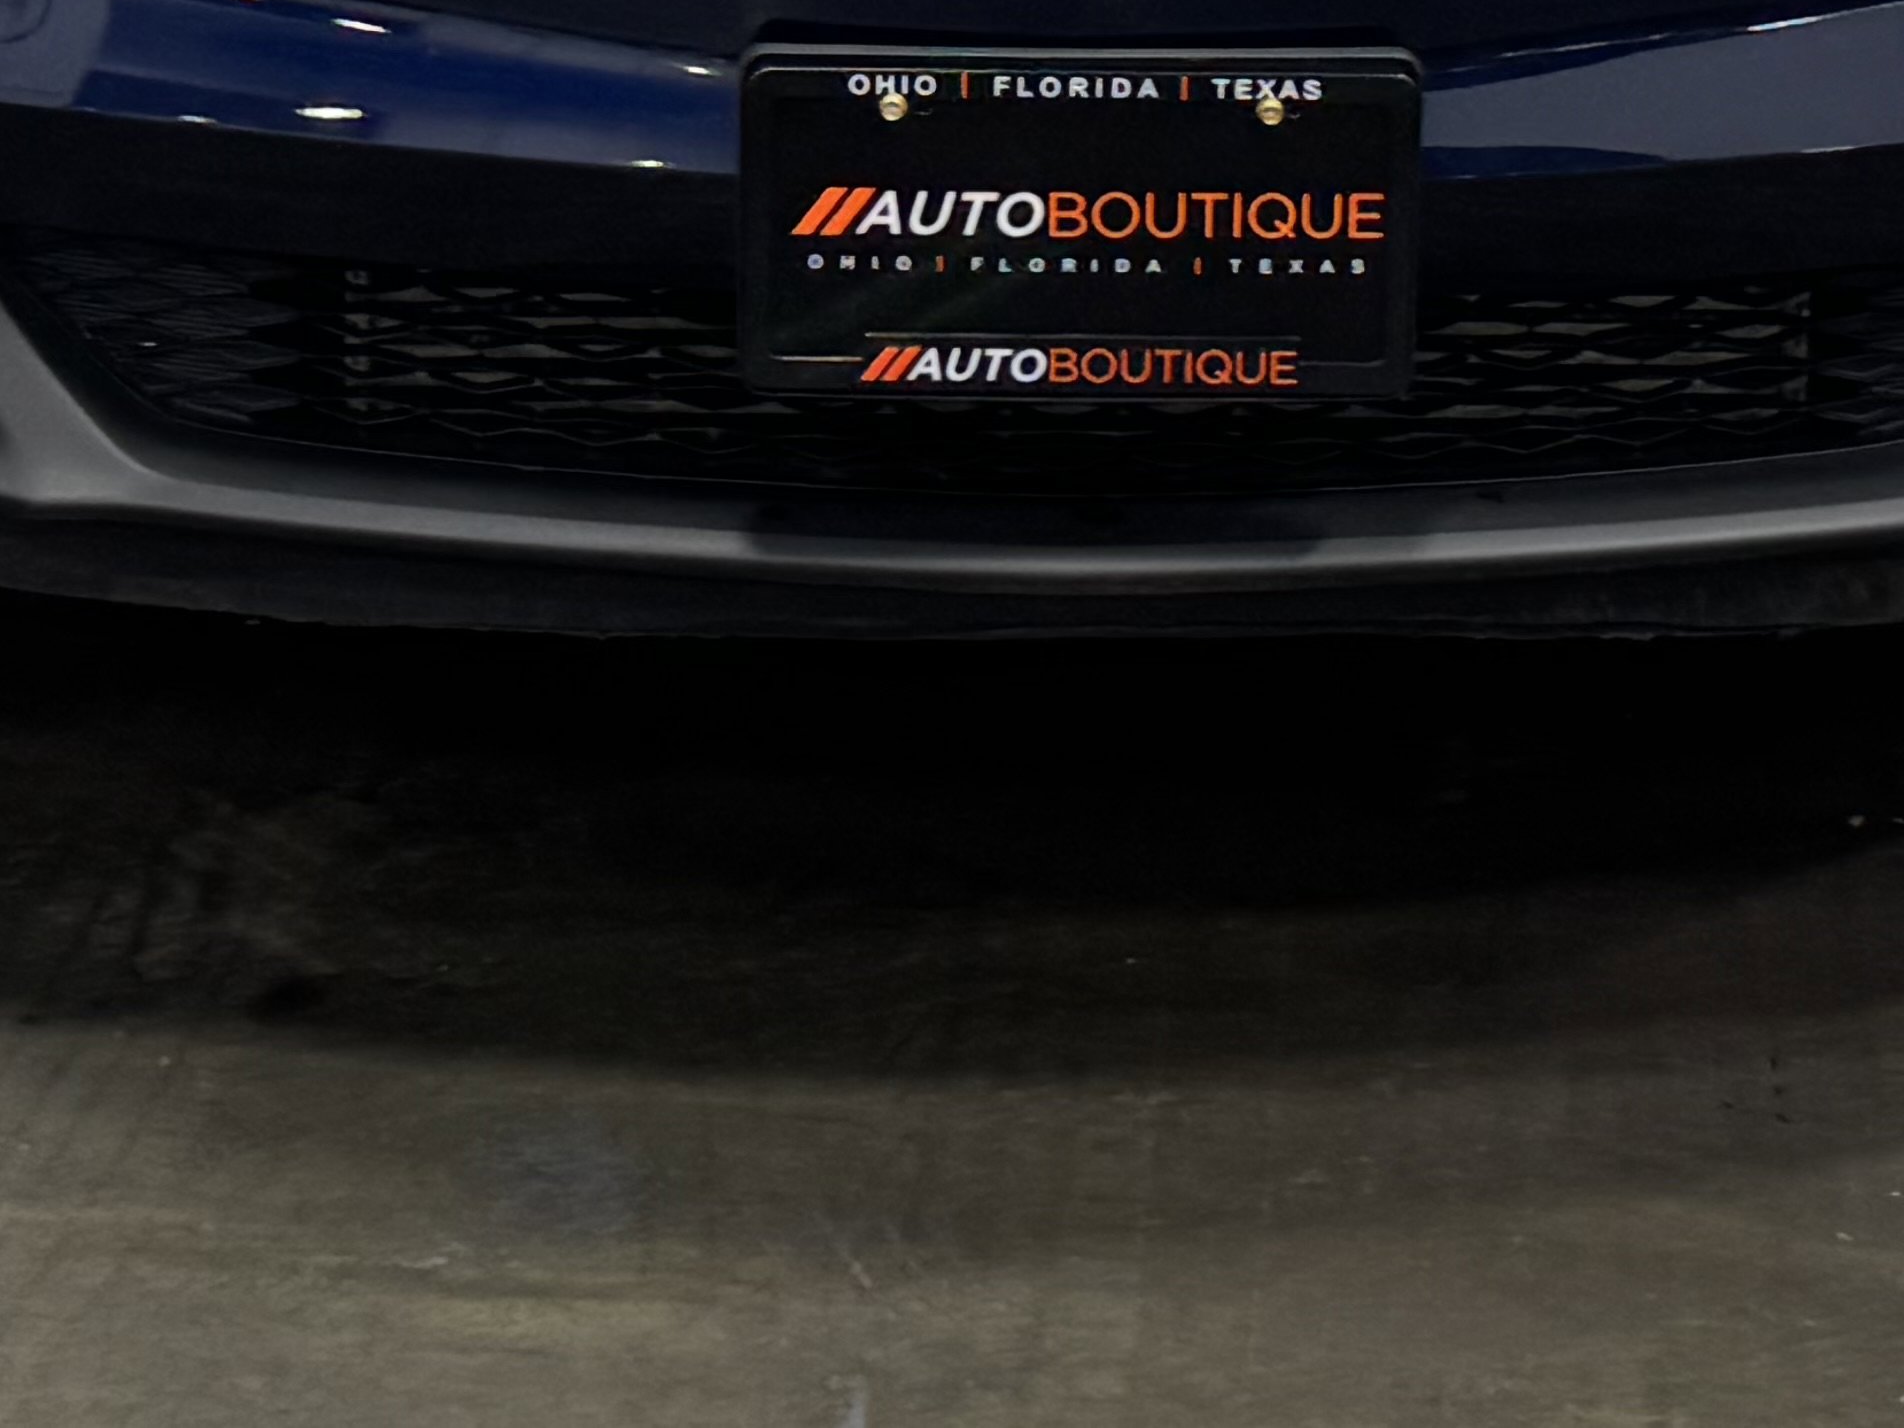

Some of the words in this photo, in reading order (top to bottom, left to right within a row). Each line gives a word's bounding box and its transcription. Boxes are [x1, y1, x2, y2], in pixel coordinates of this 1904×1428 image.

[848, 73, 938, 96] OHIO
[993, 76, 1161, 99] FLORIDA
[1211, 78, 1324, 101] TEXAS
[854, 189, 1386, 240] AUTOBOUTIQUE
[806, 253, 913, 272] OHIO
[970, 255, 1163, 274] FLORIDA
[1228, 258, 1366, 275] TEXAS
[906, 346, 1300, 386] AUTOBOUTIQUE
